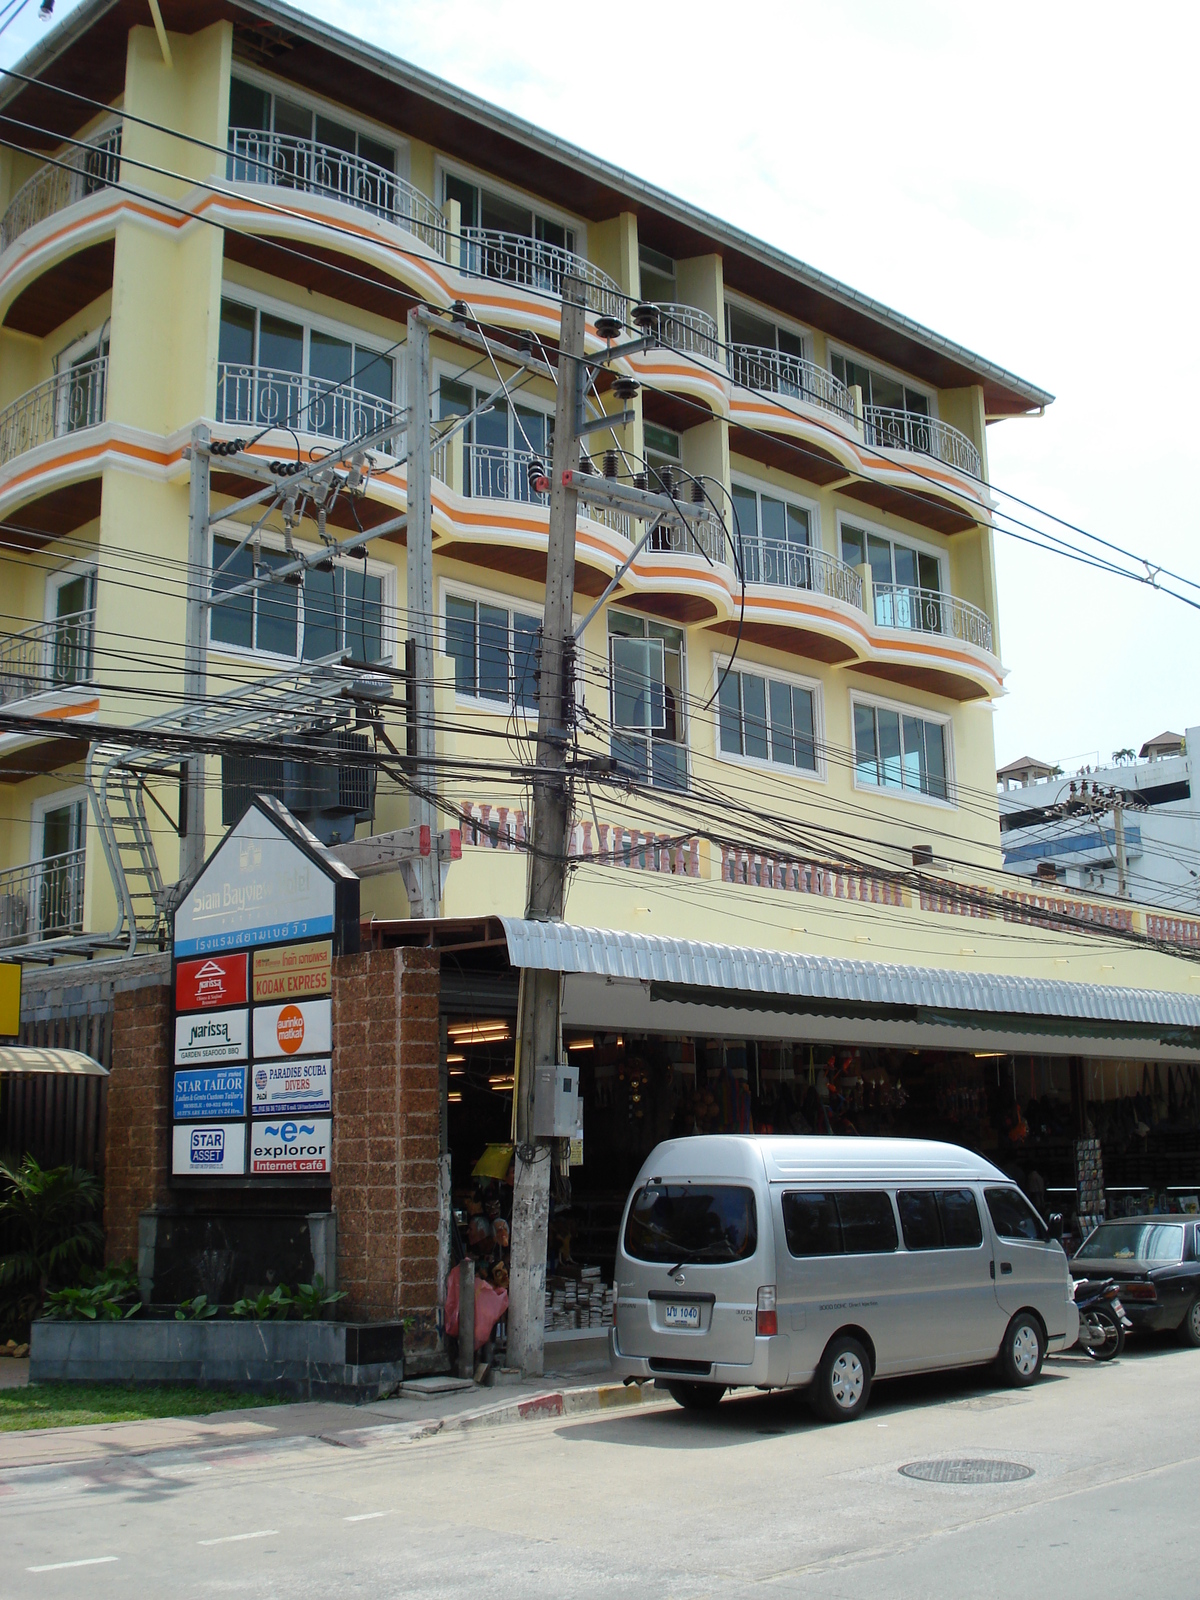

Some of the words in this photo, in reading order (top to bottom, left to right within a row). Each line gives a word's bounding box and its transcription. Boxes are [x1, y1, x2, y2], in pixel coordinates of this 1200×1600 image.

[193, 888, 221, 913] Siam
[195, 922, 308, 951] โรงแรมสยามเบย์วิว
[256, 978, 285, 995] KODAK
[287, 972, 327, 992] EXPRESS
[277, 1016, 304, 1029] aurinko
[181, 1050, 202, 1059] GARDEN
[202, 1048, 227, 1057] SEAFOOD
[228, 1047, 240, 1055] BBQ
[269, 1066, 302, 1080] PARADISE
[303, 1064, 327, 1077] SCUBA
[177, 1080, 202, 1093] STAR
[203, 1078, 243, 1091] TAILOR
[285, 1079, 310, 1091] DIVERS
[193, 1134, 222, 1147] STAR
[192, 1150, 222, 1161] ASSET
[254, 1144, 326, 1158] exploror
[256, 1161, 297, 1171] Internet
[299, 1159, 323, 1170] café
[680, 1307, 698, 1318] 1040
